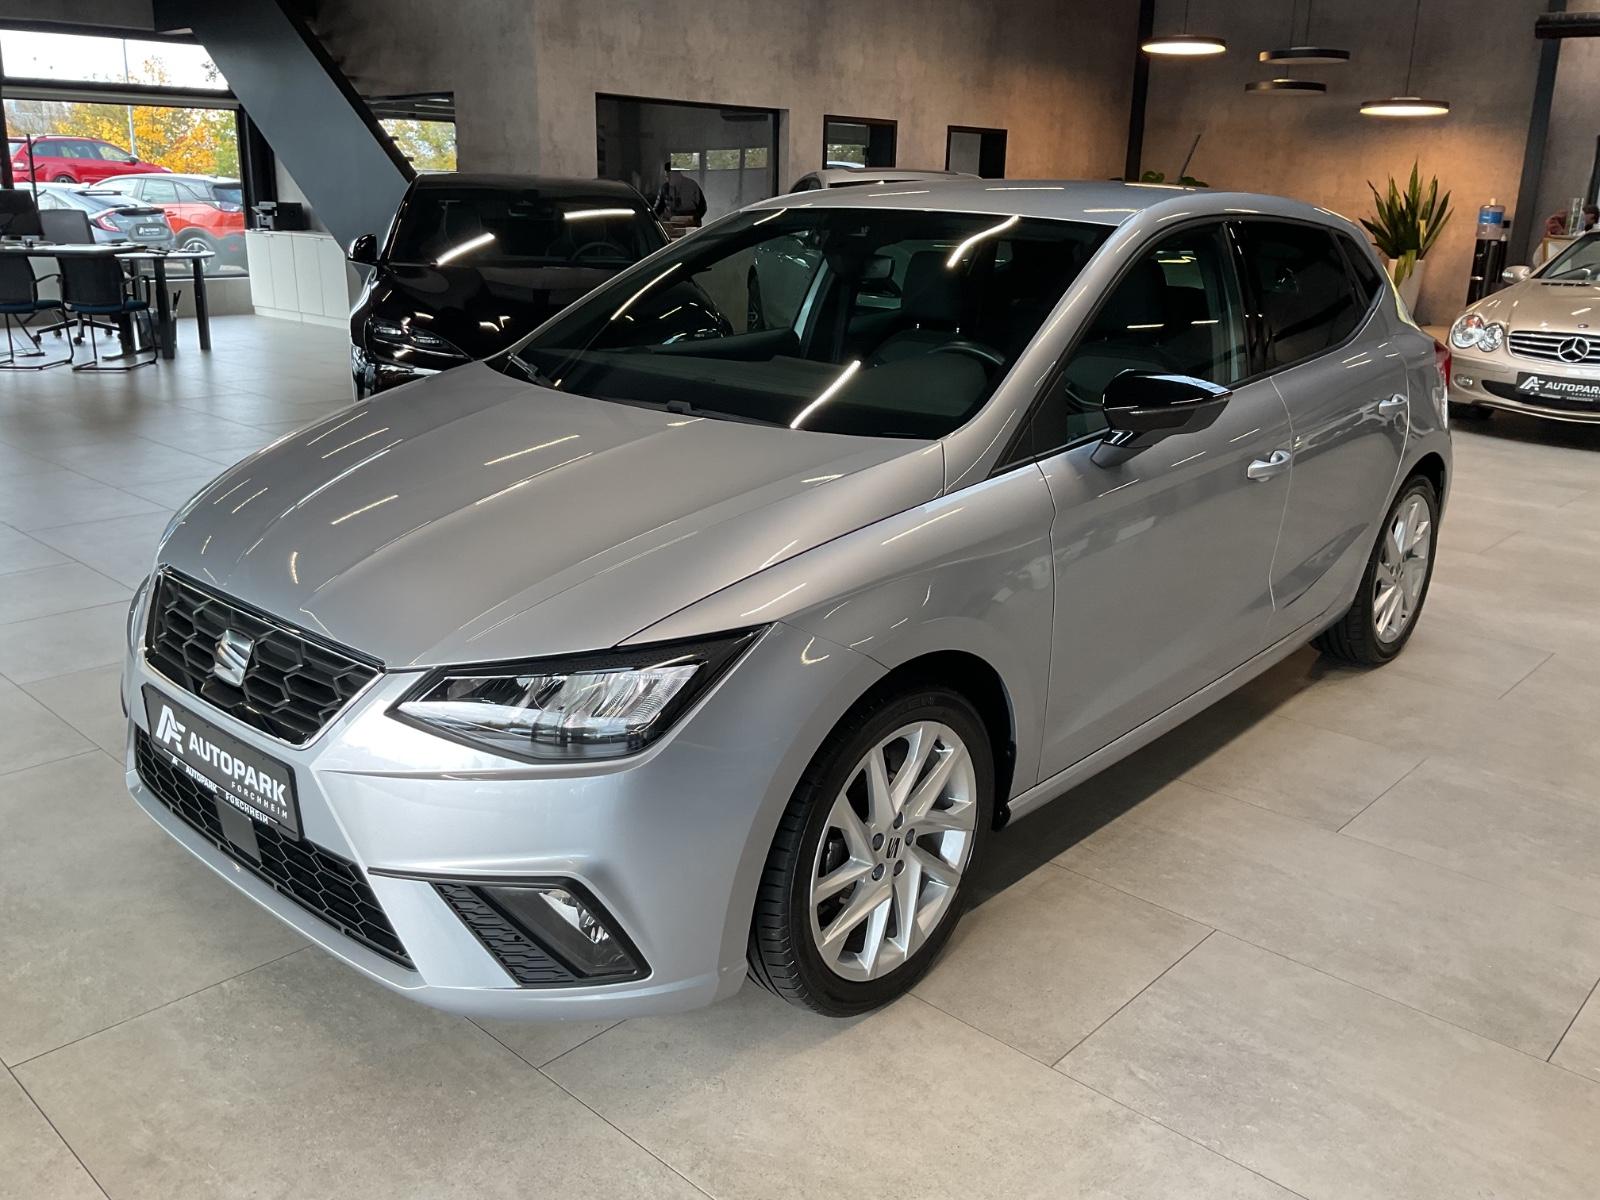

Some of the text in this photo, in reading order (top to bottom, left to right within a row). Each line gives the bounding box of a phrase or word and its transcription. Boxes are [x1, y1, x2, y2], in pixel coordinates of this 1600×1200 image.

[1545, 382, 1600, 394] AUTOPAR
[189, 731, 287, 807] AUTOPARK
[185, 765, 269, 825] AUTOPARK FORCHHEIM
[231, 781, 288, 819] FORCHHEIM
